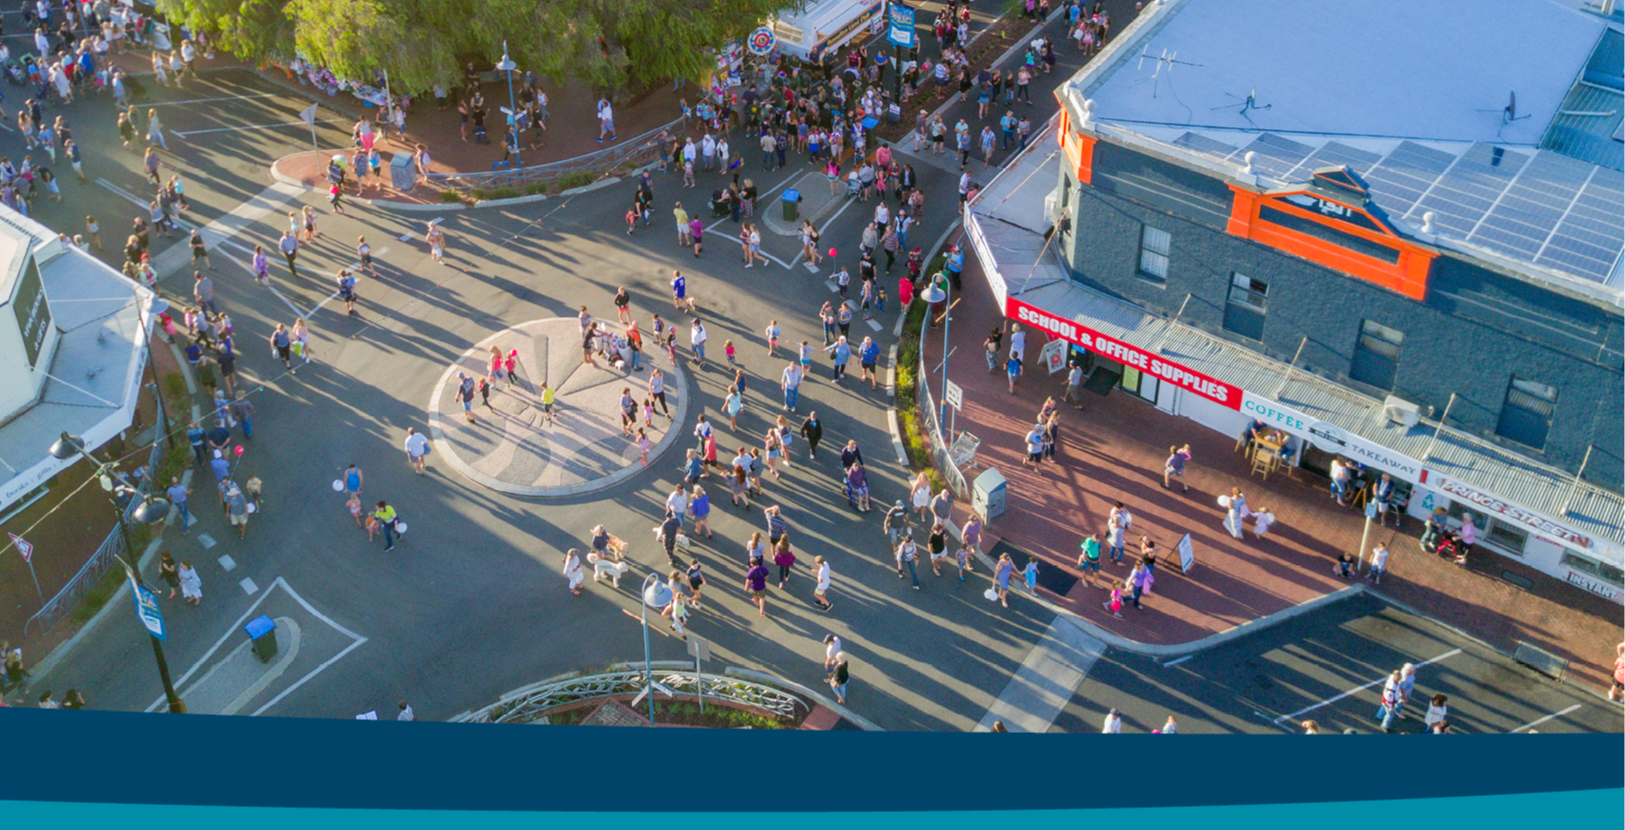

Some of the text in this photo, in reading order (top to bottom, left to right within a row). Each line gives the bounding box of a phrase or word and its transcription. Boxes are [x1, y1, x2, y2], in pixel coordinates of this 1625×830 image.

[1018, 306, 1078, 341] SCHOOL
[1081, 332, 1093, 347] &
[1095, 337, 1148, 369] OFFICE
[1150, 359, 1228, 402] SUPPLIES
[1245, 400, 1416, 475] COFFEE TAKEAWAY
[6, 481, 29, 498] books
[1441, 480, 1503, 511] PRINCE
[1504, 507, 1579, 539] STREET
[1567, 571, 1618, 600] INSTANT
